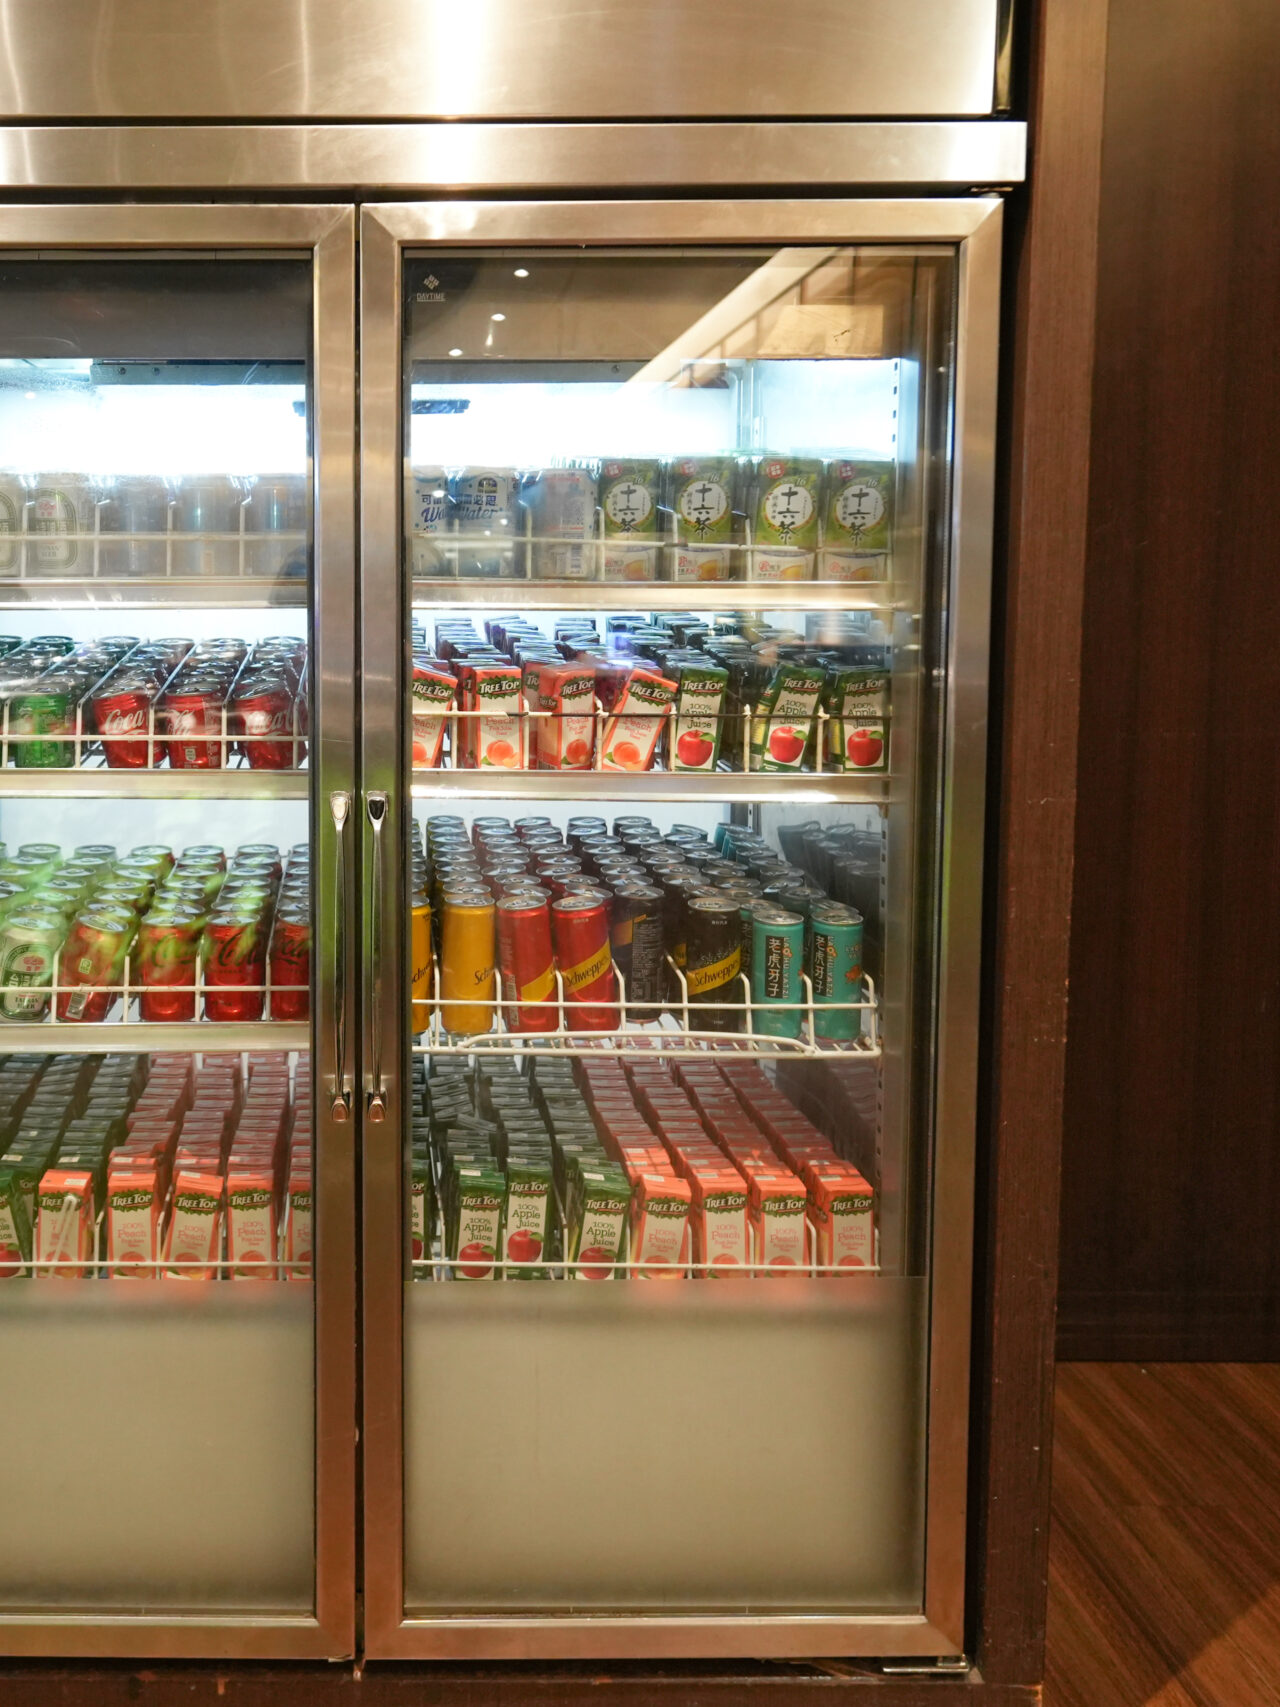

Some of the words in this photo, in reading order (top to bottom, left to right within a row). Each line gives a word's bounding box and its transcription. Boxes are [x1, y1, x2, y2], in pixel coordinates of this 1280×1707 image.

[417, 292, 445, 301] DAYTIME
[693, 483, 715, 541] 十六茶
[778, 486, 801, 546] 十六茶
[848, 487, 871, 547] 十六茶
[480, 682, 500, 694] TREE
[501, 680, 520, 691] TOP
[562, 684, 579, 696] TREE
[579, 680, 594, 690] TOP
[683, 680, 705, 690] TREE
[705, 680, 724, 690] TOP
[784, 678, 802, 688] TREE
[803, 679, 822, 689] TOP
[846, 681, 864, 692] TREE
[412, 681, 433, 695] TREE
[433, 686, 453, 698] TOP
[631, 684, 653, 698] TREE
[652, 688, 672, 701] TOP
[786, 700, 807, 708] 100%
[685, 708, 713, 720] Apple
[778, 704, 807, 717] Apple
[687, 719, 712, 729] Juice
[768, 937, 781, 998] 老虎牙子
[815, 934, 826, 994] 老虎牙子
[510, 1182, 530, 1191] TREE
[530, 1181, 548, 1191] TOP
[112, 1197, 133, 1207] TREE
[133, 1193, 152, 1203] TOP
[178, 1197, 198, 1207] TREE
[198, 1198, 217, 1209] TOP
[231, 1196, 250, 1206] TREE
[253, 1192, 271, 1203] TOP
[462, 1197, 482, 1206] TREE
[483, 1196, 501, 1205] TOP
[586, 1200, 606, 1210] TREE
[606, 1199, 626, 1210] TOP
[706, 1197, 726, 1208] TREE
[727, 1195, 746, 1205] TOP
[647, 1201, 668, 1212] TREE
[668, 1202, 688, 1212] TOP
[765, 1201, 785, 1211] TREE
[786, 1199, 805, 1209] TOP
[833, 1201, 853, 1211] TREE
[853, 1199, 873, 1208] TOP
[512, 1210, 540, 1219] Apple
[470, 1217, 491, 1225] 100%
[516, 1219, 540, 1229] Juice
[593, 1221, 615, 1230] 100%
[463, 1223, 493, 1233] Apple
[586, 1227, 616, 1238] Apple
[468, 1232, 492, 1242] Juice
[589, 1238, 615, 1247] Juice
